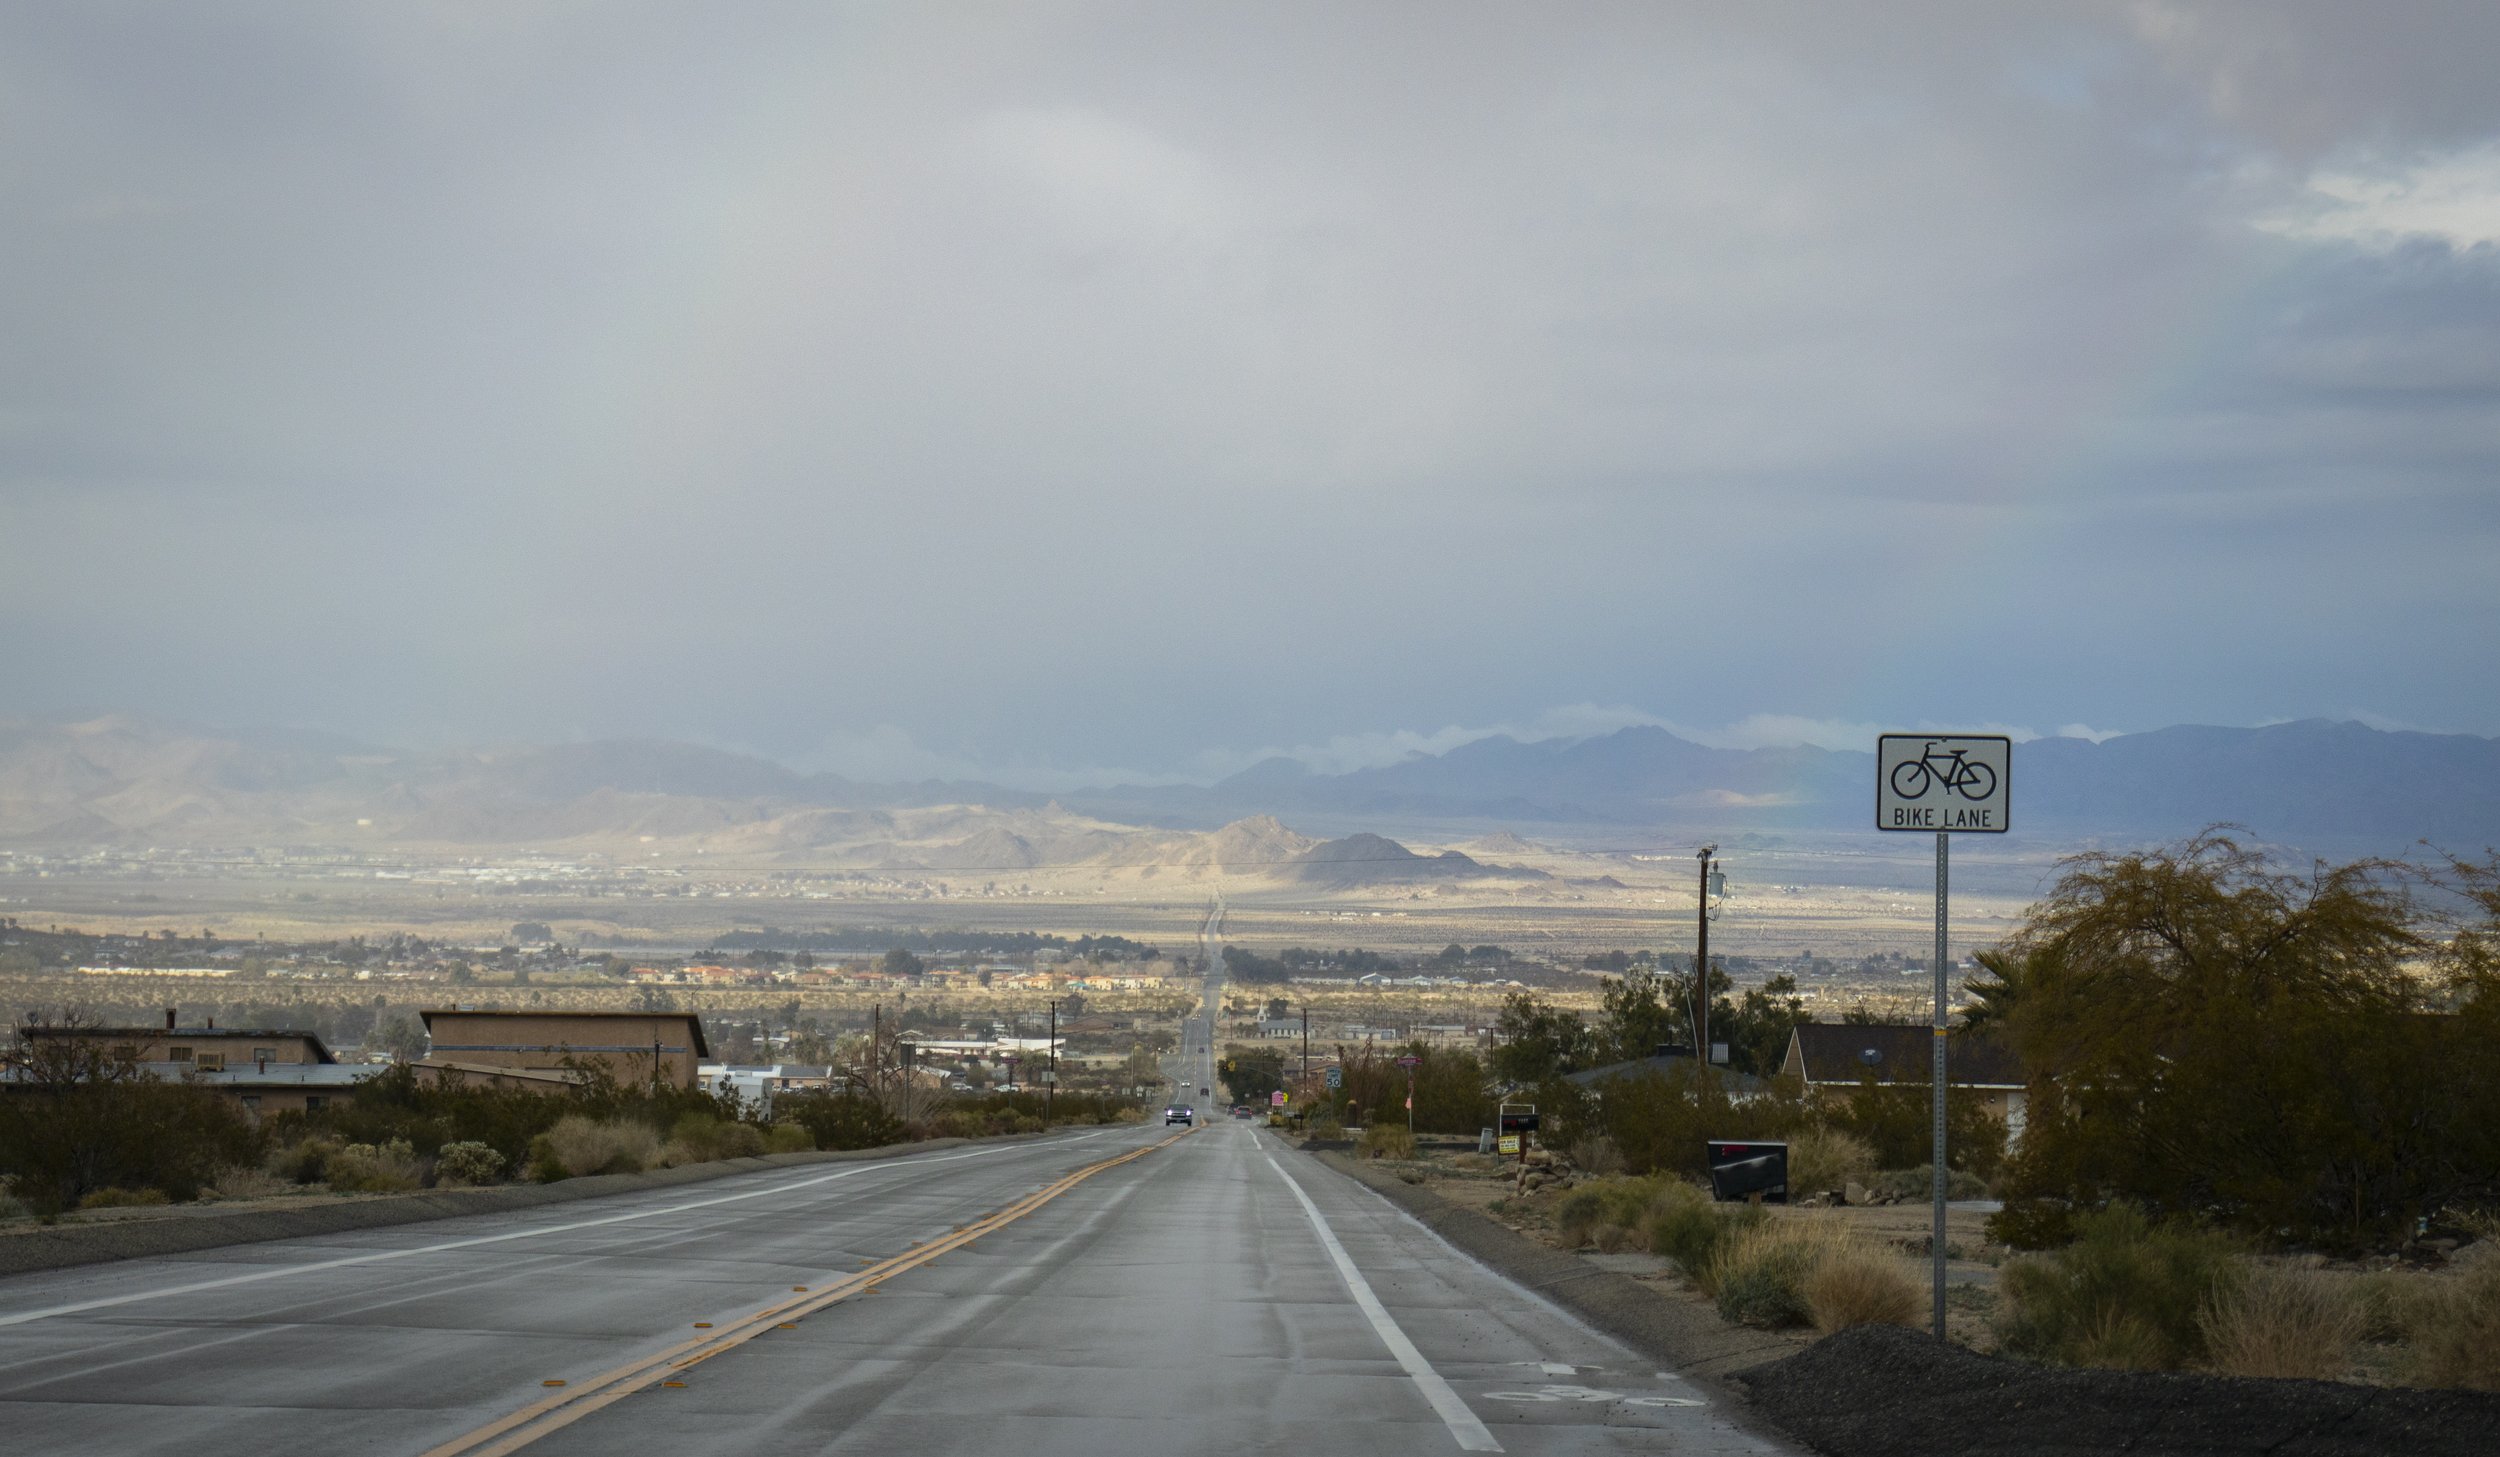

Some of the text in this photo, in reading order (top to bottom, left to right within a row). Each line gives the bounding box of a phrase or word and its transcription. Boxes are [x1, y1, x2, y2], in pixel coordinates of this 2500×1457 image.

[1894, 808, 1992, 827] BIKE LANE
[1327, 1078, 1340, 1086] 50
